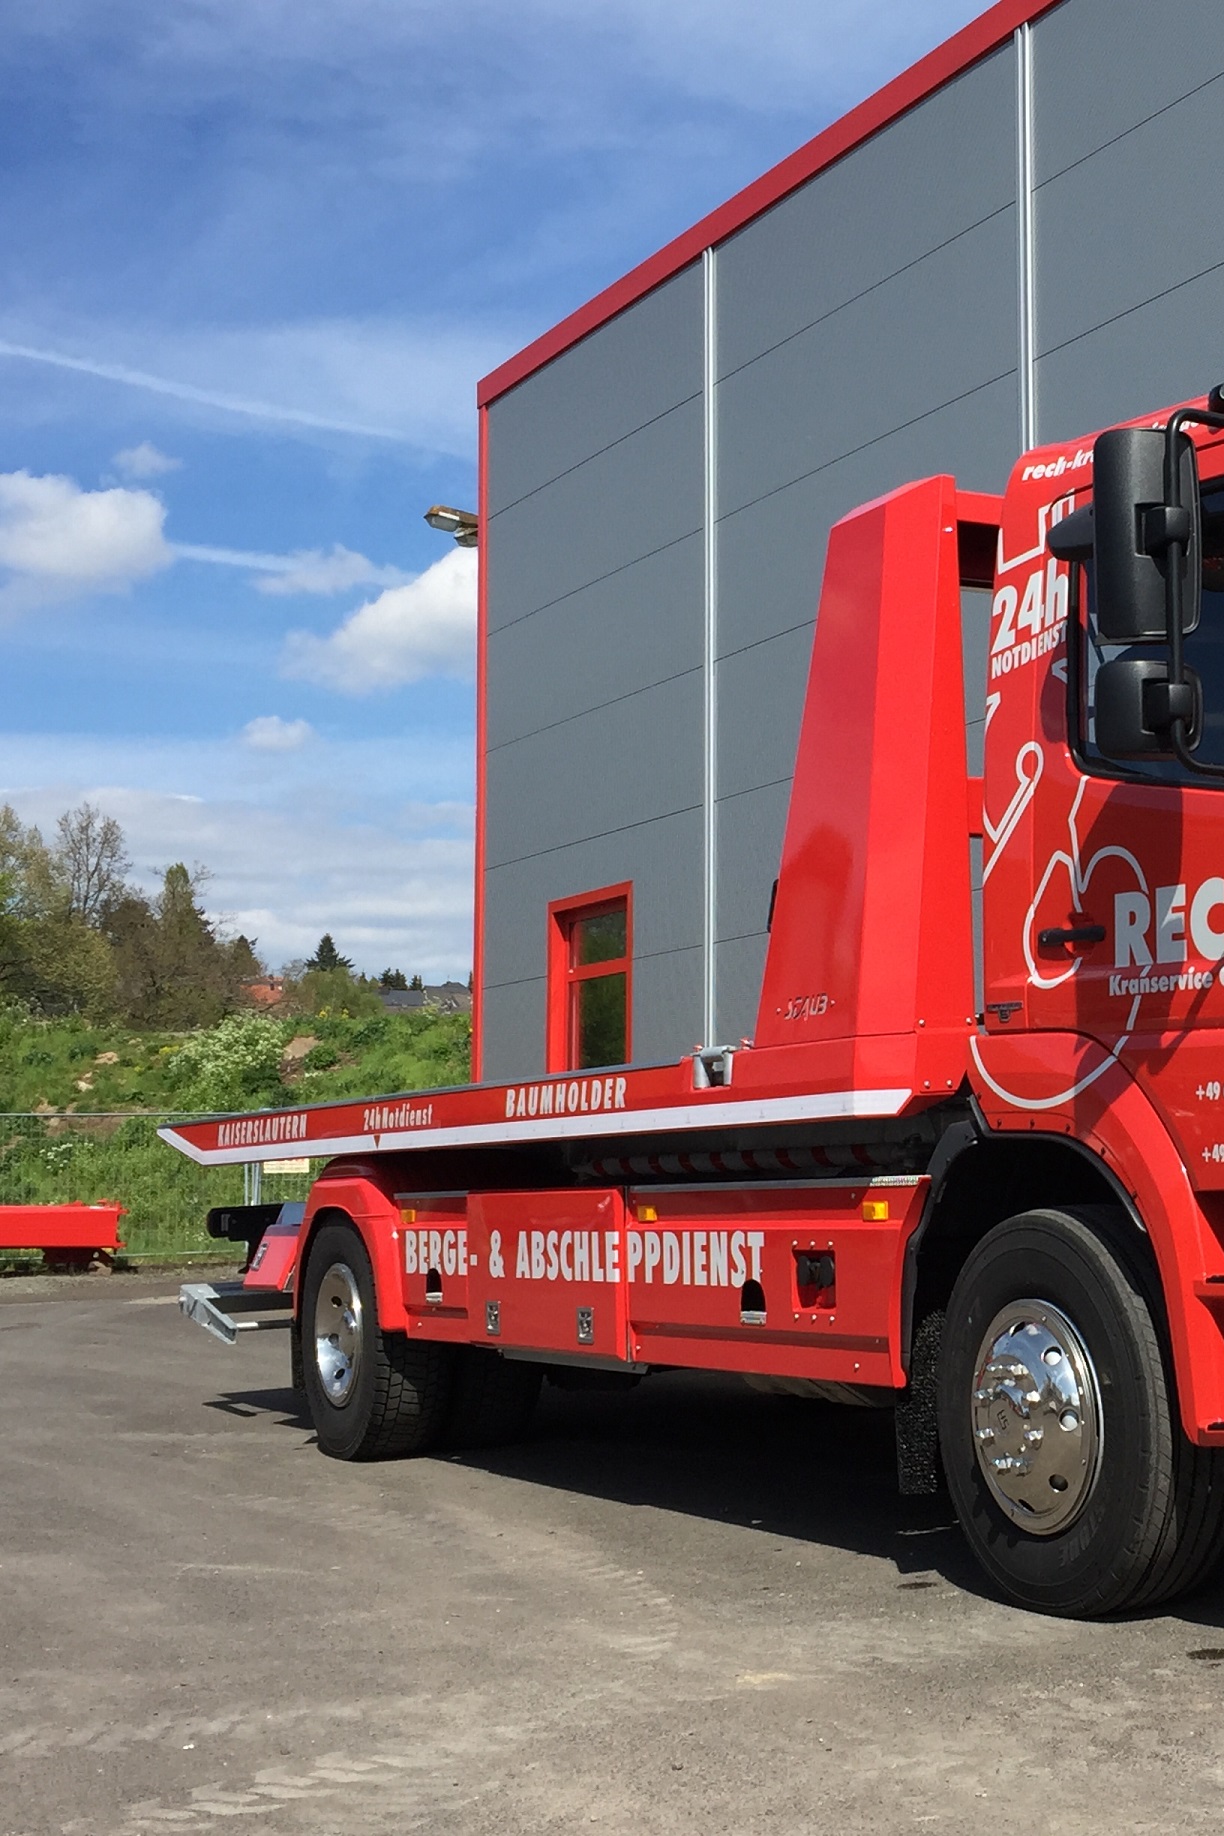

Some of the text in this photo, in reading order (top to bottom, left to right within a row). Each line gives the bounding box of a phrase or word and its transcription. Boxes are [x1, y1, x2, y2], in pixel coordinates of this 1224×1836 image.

[991, 556, 1069, 656] 24h
[991, 620, 1069, 680] NOTDIENST
[1108, 965, 1214, 997] Kranservice
[505, 1077, 627, 1118] BAUMHOLDER
[1195, 1081, 1221, 1101] +49
[217, 1113, 308, 1147] KAISERSLAUTERN
[488, 1229, 505, 1278] &
[516, 1230, 764, 1288] ABSCHLEPPDIENST
